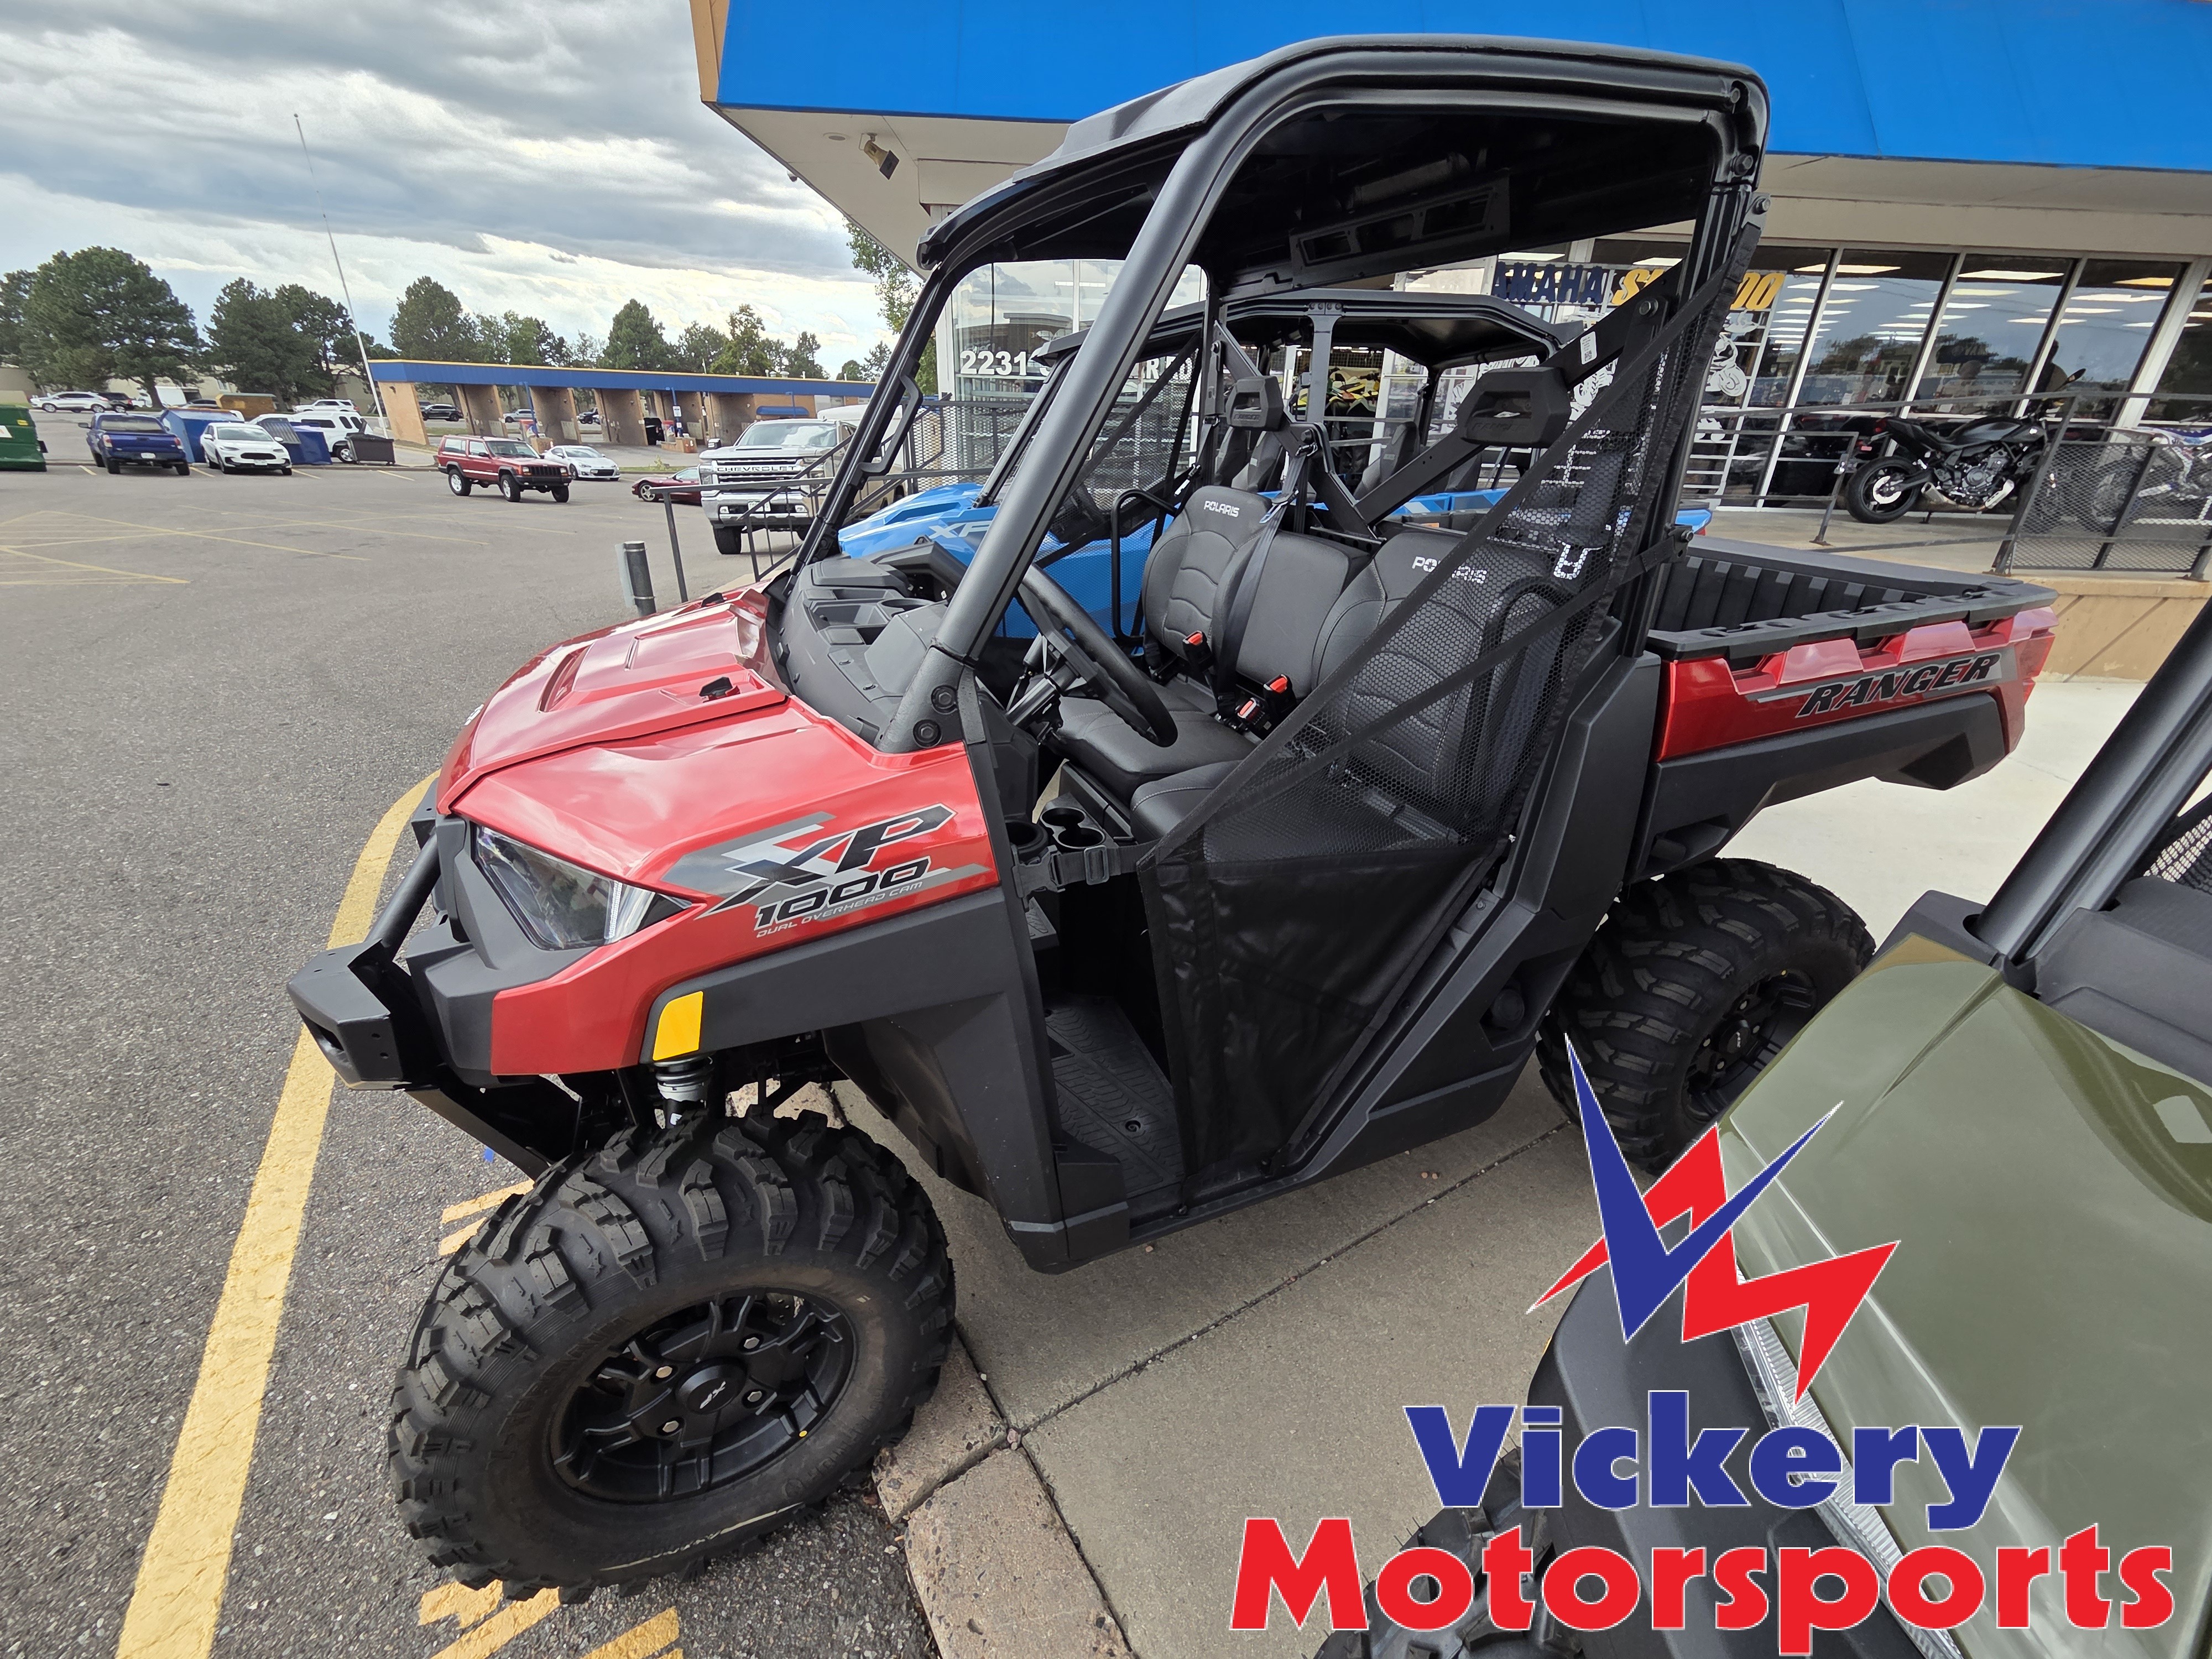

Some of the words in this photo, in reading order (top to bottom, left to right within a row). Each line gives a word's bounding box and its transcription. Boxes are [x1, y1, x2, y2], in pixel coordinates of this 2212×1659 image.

[1492, 261, 1604, 304] AMAHA
[959, 350, 1027, 376] 2231
[1203, 500, 1240, 518] POLARIS
[1411, 556, 1488, 585] PORIS
[1795, 653, 2002, 719] RANGER
[695, 802, 958, 920] XP
[753, 856, 932, 931] 1000
[756, 921, 798, 938] DUAL
[801, 893, 886, 925] OVERHEAD
[889, 881, 924, 898] CAM
